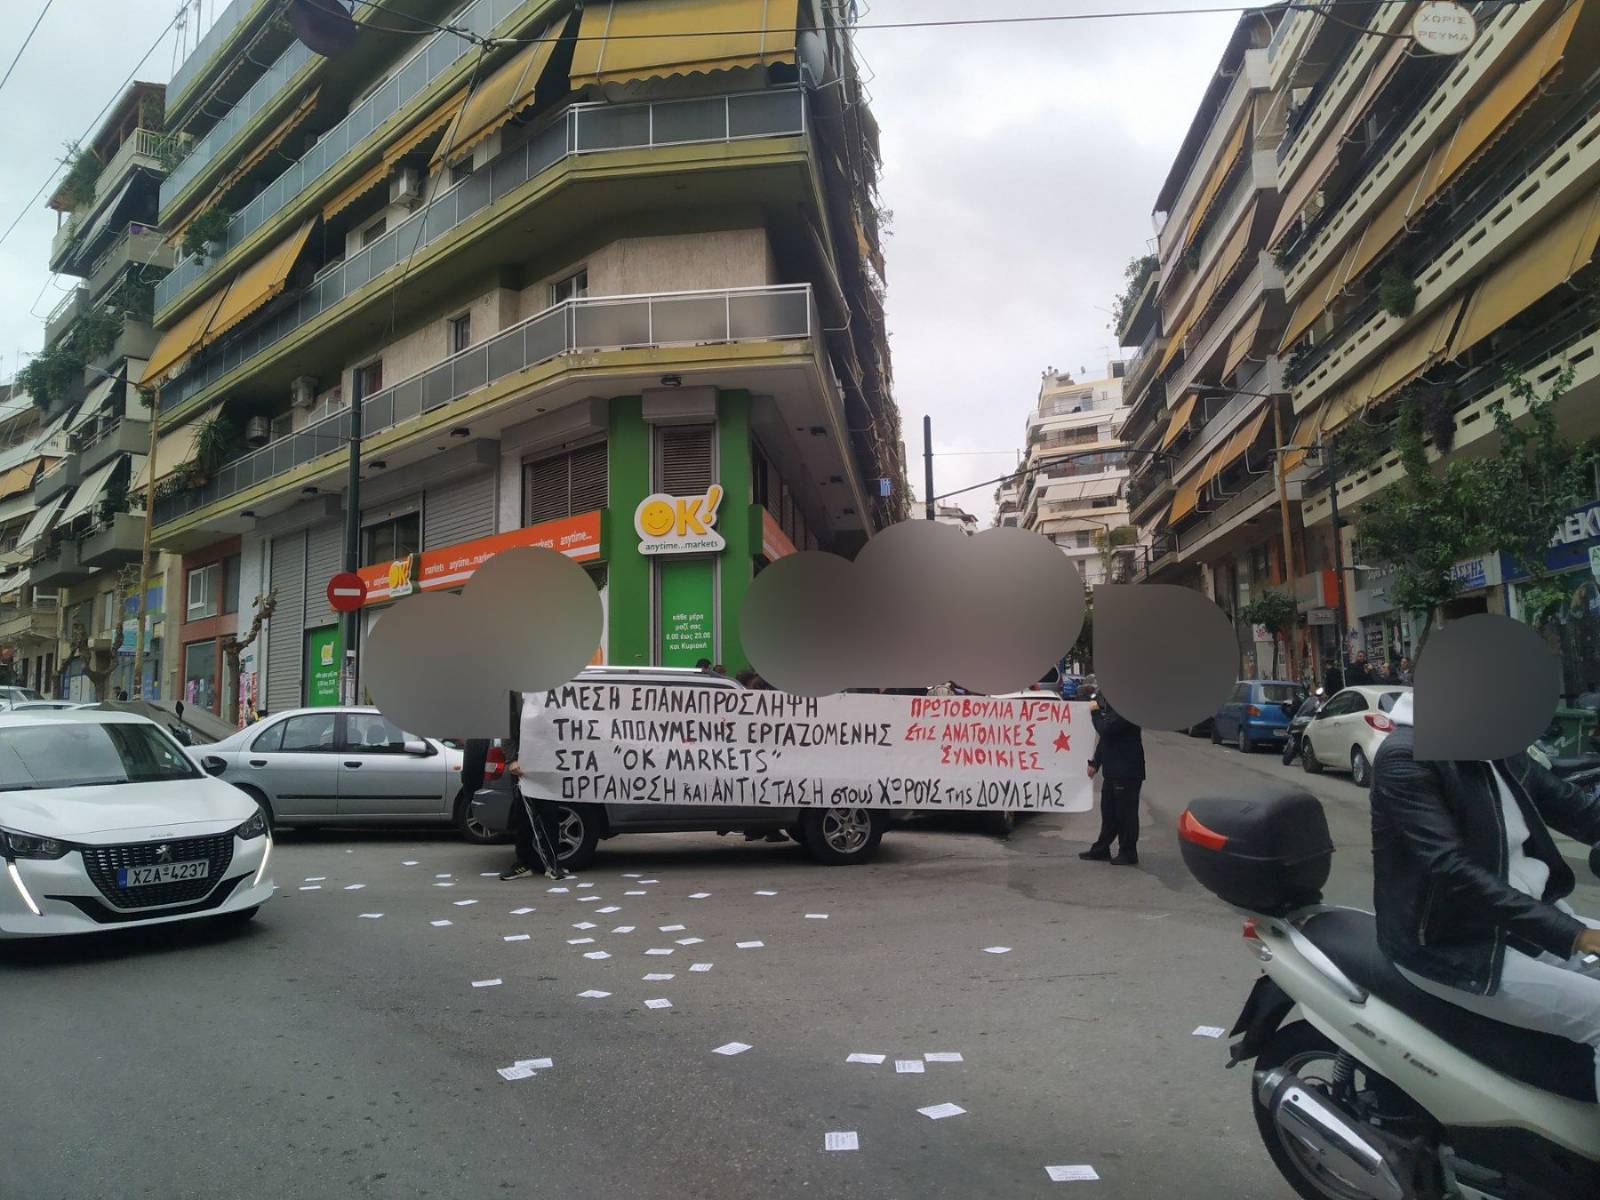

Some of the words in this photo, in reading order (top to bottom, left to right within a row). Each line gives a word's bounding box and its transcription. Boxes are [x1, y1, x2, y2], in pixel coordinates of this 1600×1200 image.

[544, 686, 620, 711] ΑΜΕΣΗ
[631, 687, 818, 718] ΕΠΑΝΑΠΡΟΣΛΗΨΗ
[911, 698, 1013, 719] ΠΡΩΤΟΒΟΥΛΙΑ
[1019, 701, 1071, 724] ΑΓΩΝΑ
[553, 718, 601, 741] ΤΗΣ
[610, 719, 737, 743] ΑΠΟΛΥΜΕΝΗΣ
[748, 722, 892, 747] ΕΡΓΑΖΟΜΕΝΗΣ
[942, 722, 1036, 747] ΑΝΑΤΟΛΙΚΕΣ
[555, 749, 599, 772] ΣΤΑ
[941, 745, 1044, 770] ΣΥΝΟΙΚΙΕΣ
[562, 775, 676, 800] ΟΡΓΑΝΩΣΗ
[712, 776, 823, 805] ΑΝΤΙΣΤΑΣΗ
[878, 777, 942, 805] ΧΩΡΟΥΣ
[977, 780, 1065, 807] ΔΟΥΛΕΙΑΣ
